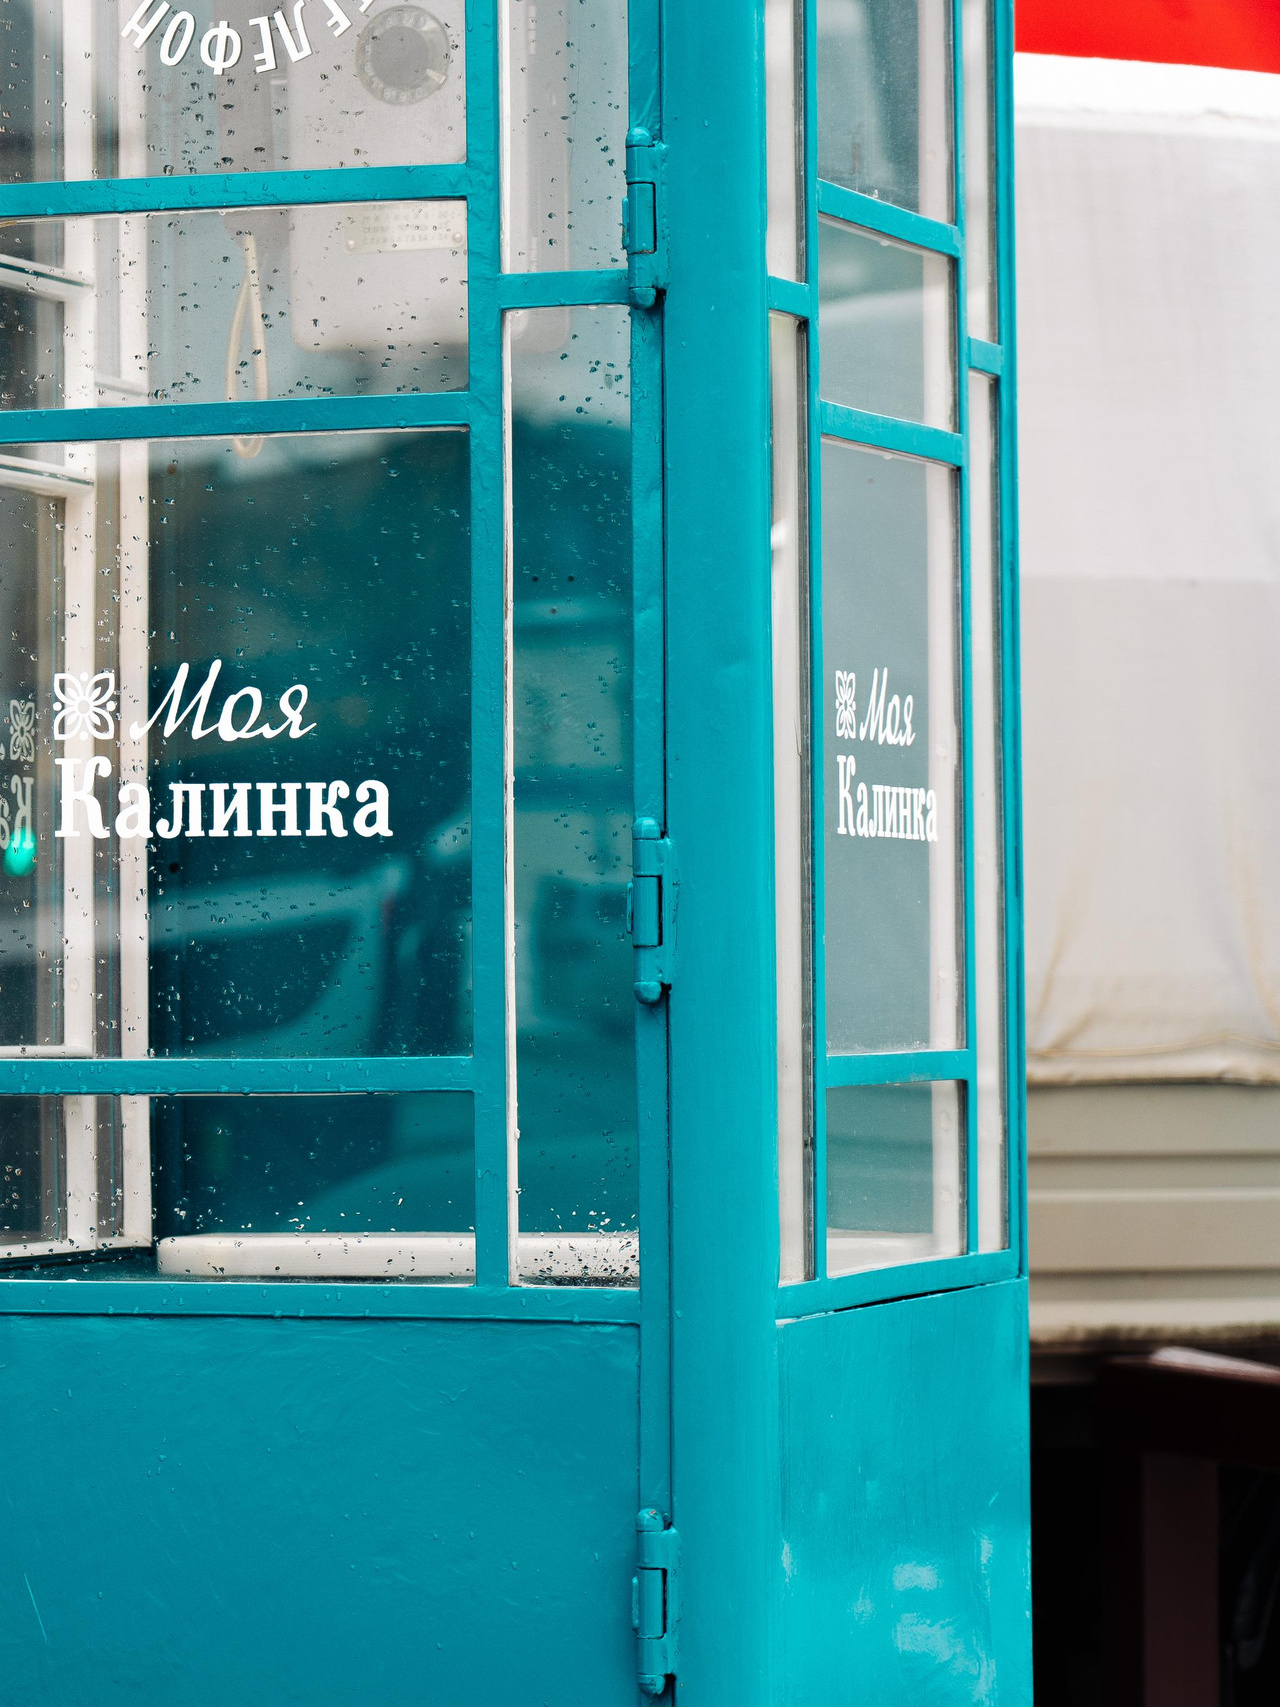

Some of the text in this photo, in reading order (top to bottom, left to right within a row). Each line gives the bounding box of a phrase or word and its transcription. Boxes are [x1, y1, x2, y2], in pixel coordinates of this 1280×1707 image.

[120, 0, 373, 75] ЕЛЕФОН
[131, 660, 317, 742] Моя
[861, 667, 916, 746] Моя
[54, 755, 394, 840] Калинка
[837, 755, 939, 842] Калинка
